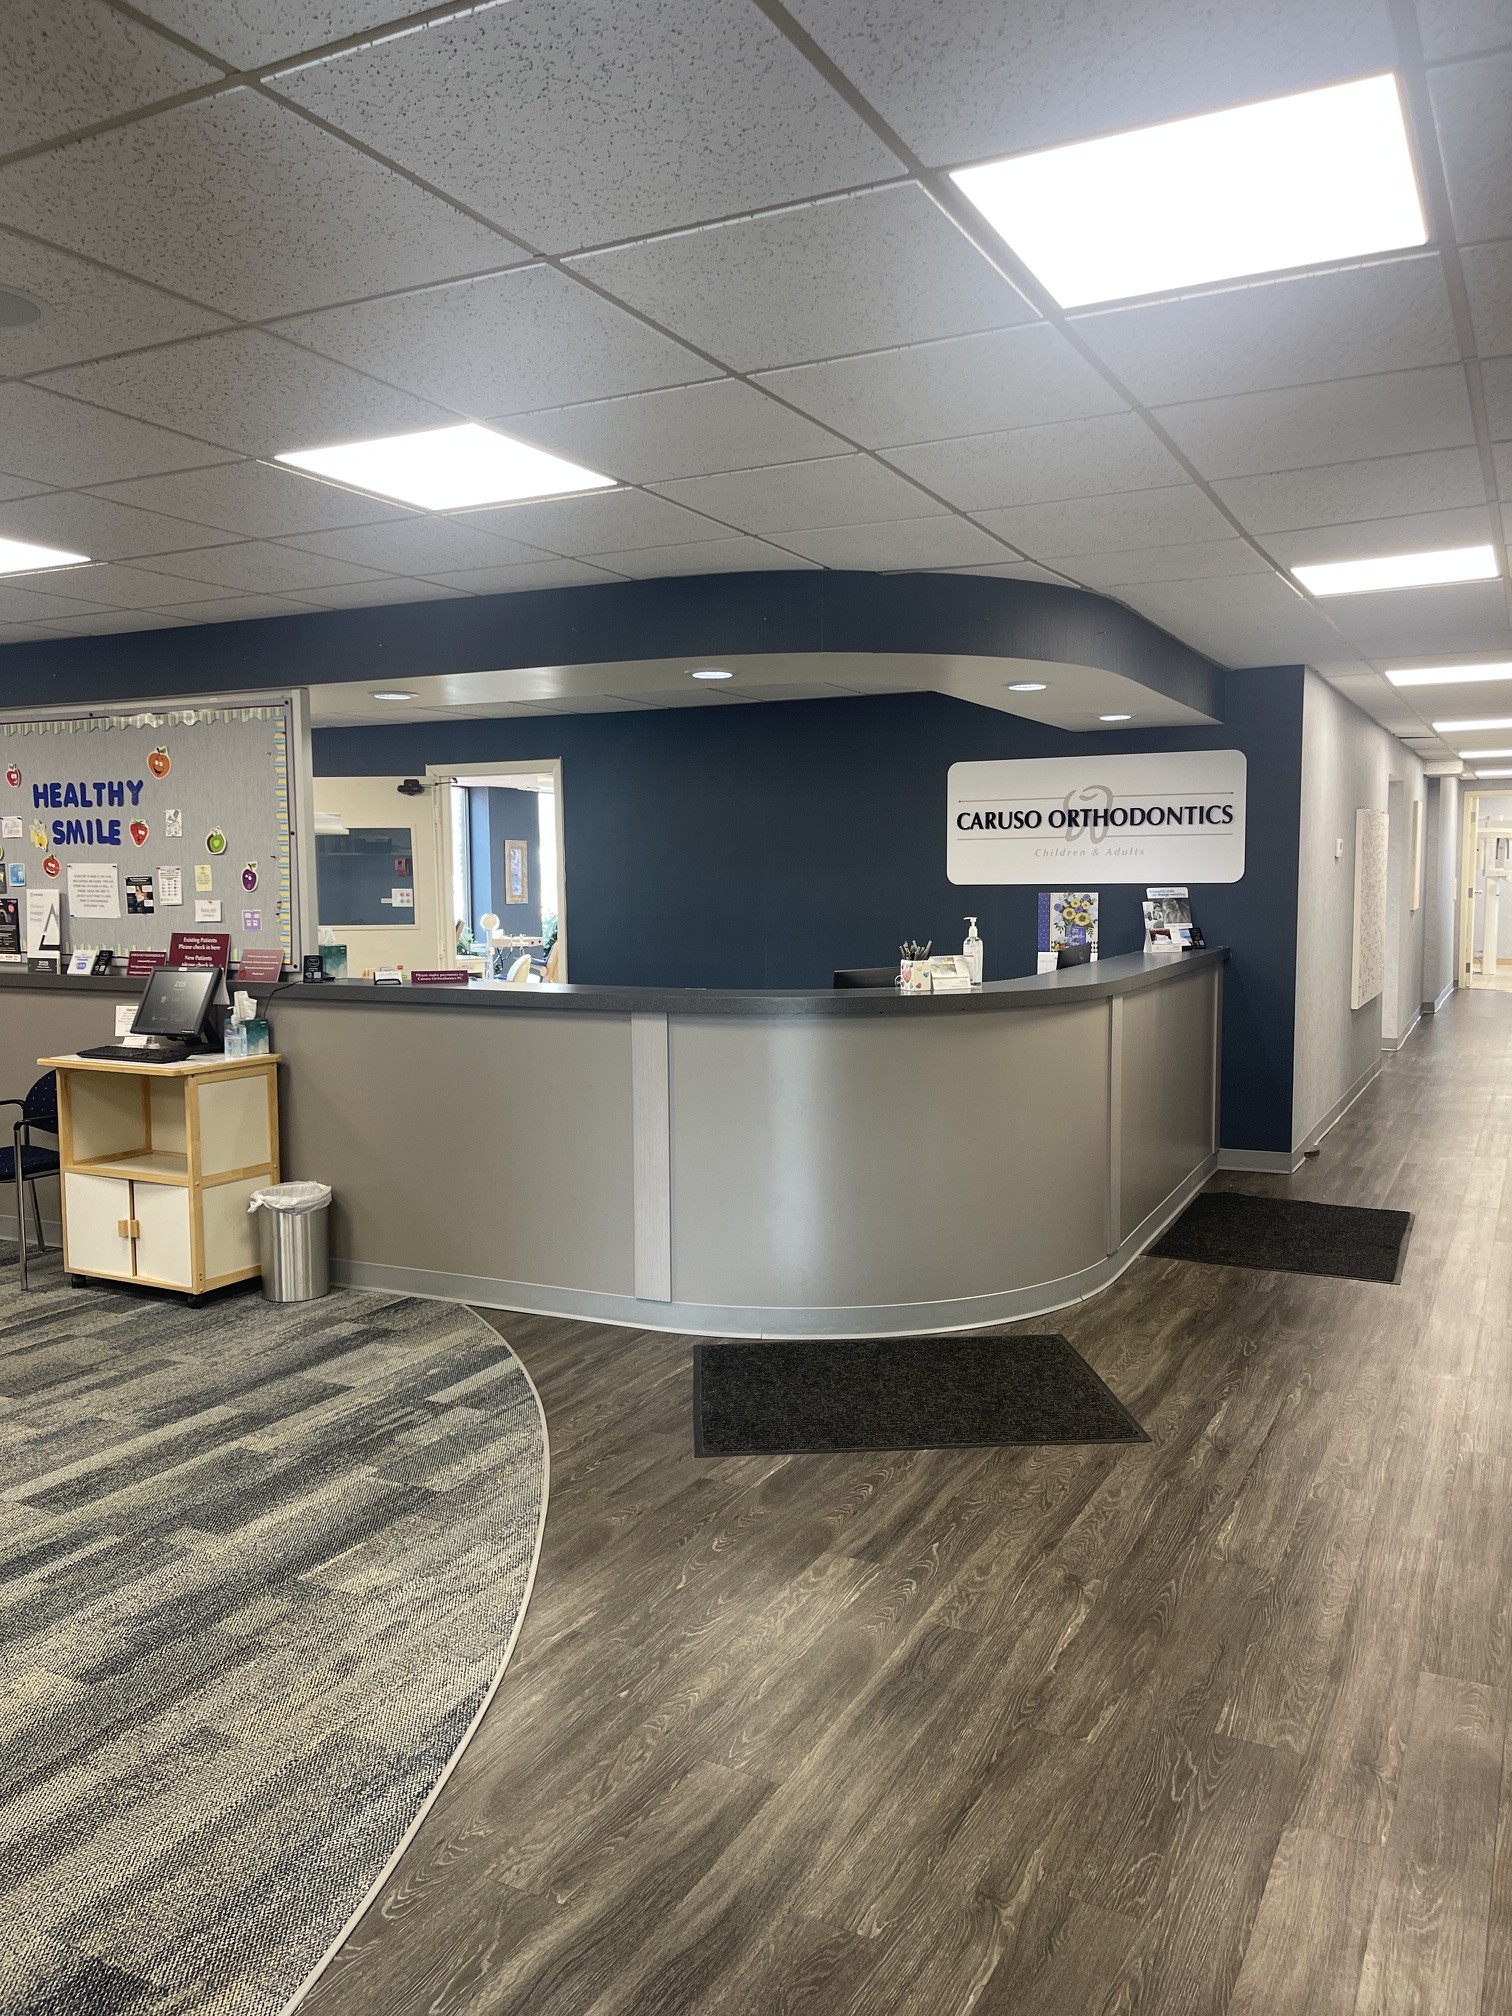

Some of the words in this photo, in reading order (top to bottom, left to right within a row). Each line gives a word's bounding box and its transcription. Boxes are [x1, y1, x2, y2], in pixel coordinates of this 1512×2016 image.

[32, 780, 144, 809] HEALTHY
[956, 810, 1042, 831] CARUSO
[1048, 804, 1234, 829] ORTHODONTICS
[52, 818, 121, 846] SMILE
[1034, 847, 1086, 858] Children
[1092, 847, 1099, 857] &
[1105, 846, 1145, 857] Adults
